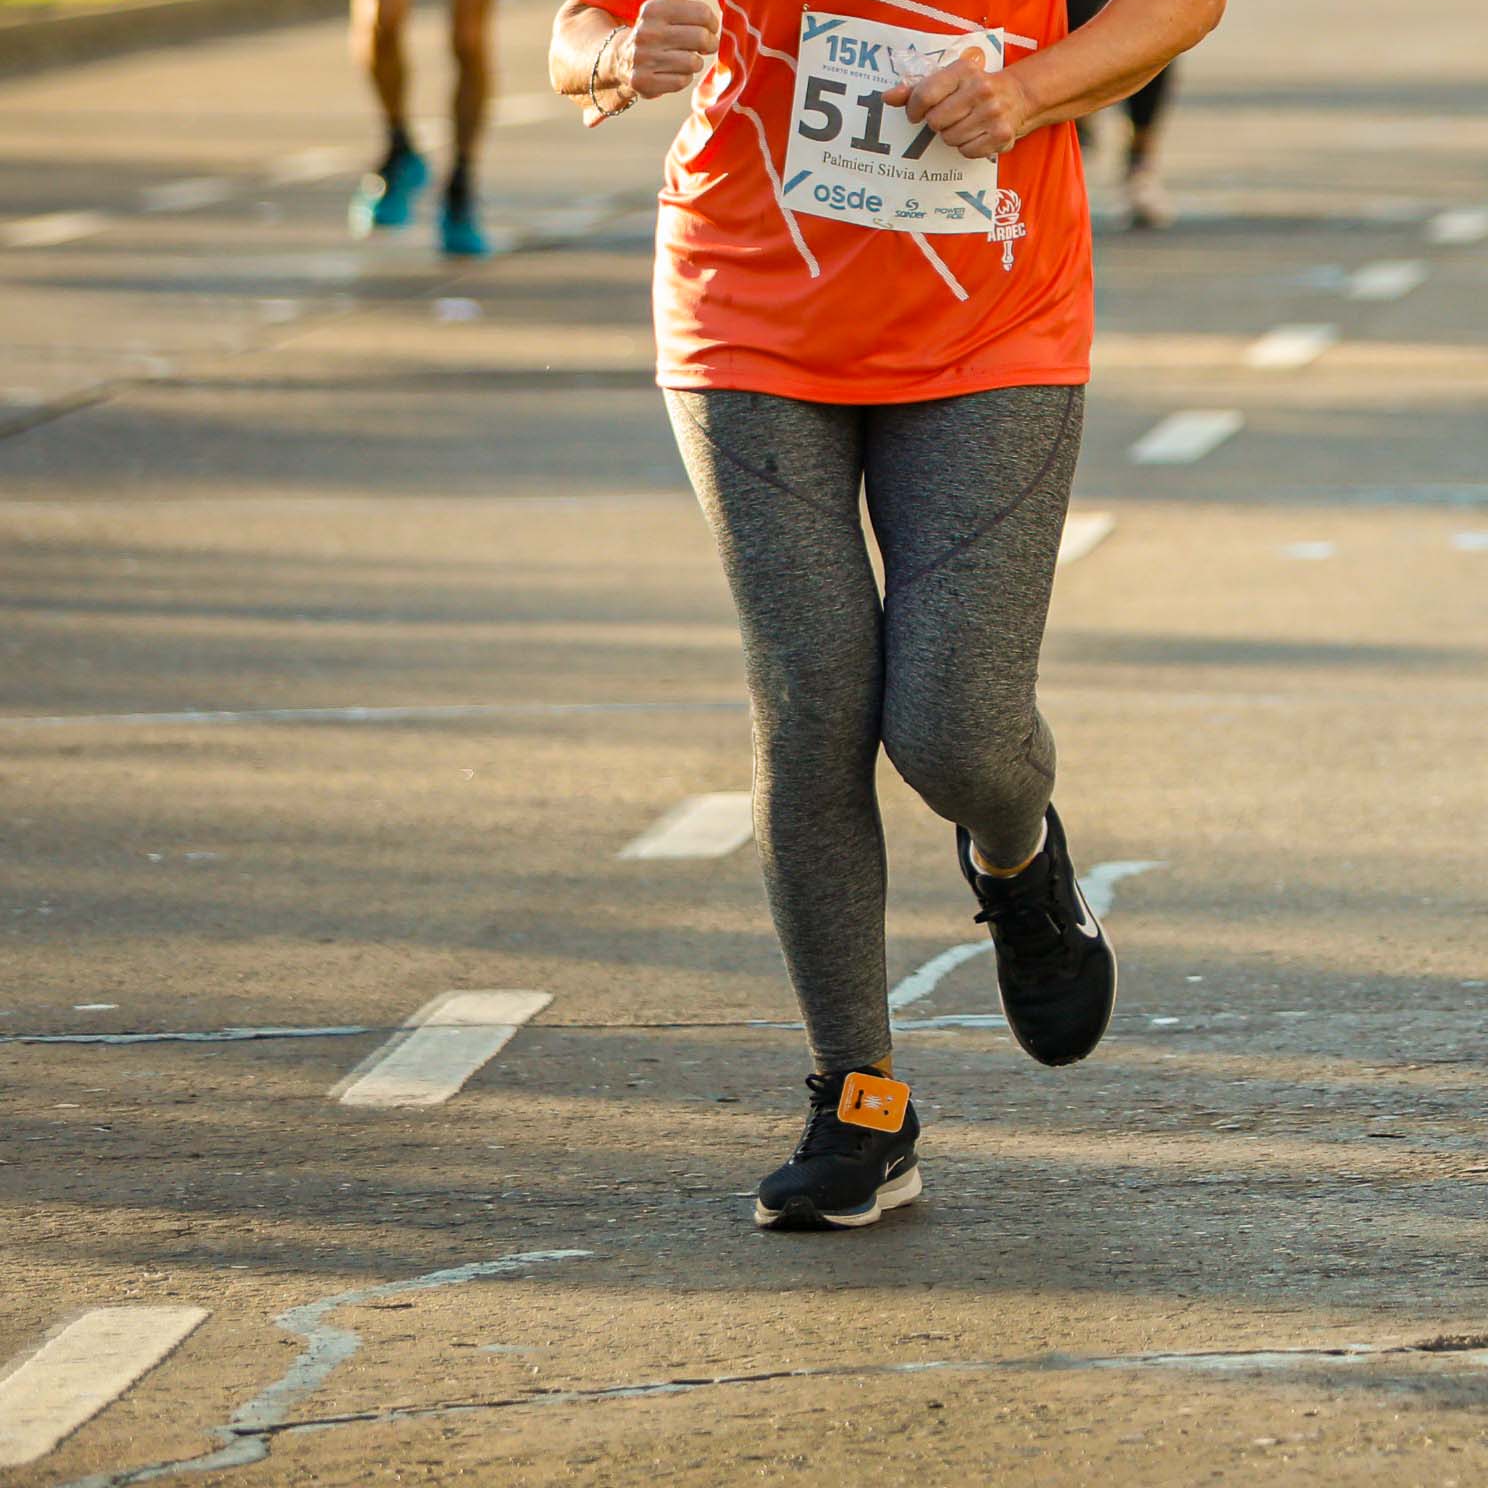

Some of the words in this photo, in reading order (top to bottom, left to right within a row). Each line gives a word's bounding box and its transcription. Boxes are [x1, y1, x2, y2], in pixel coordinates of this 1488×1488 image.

[826, 35, 882, 72] 15K
[798, 76, 937, 160] 51
[823, 151, 874, 173] Palmieri
[878, 163, 915, 181] Silvia
[920, 168, 963, 182] Amalia
[813, 183, 882, 212] osde
[987, 223, 1027, 242] ARDEC
